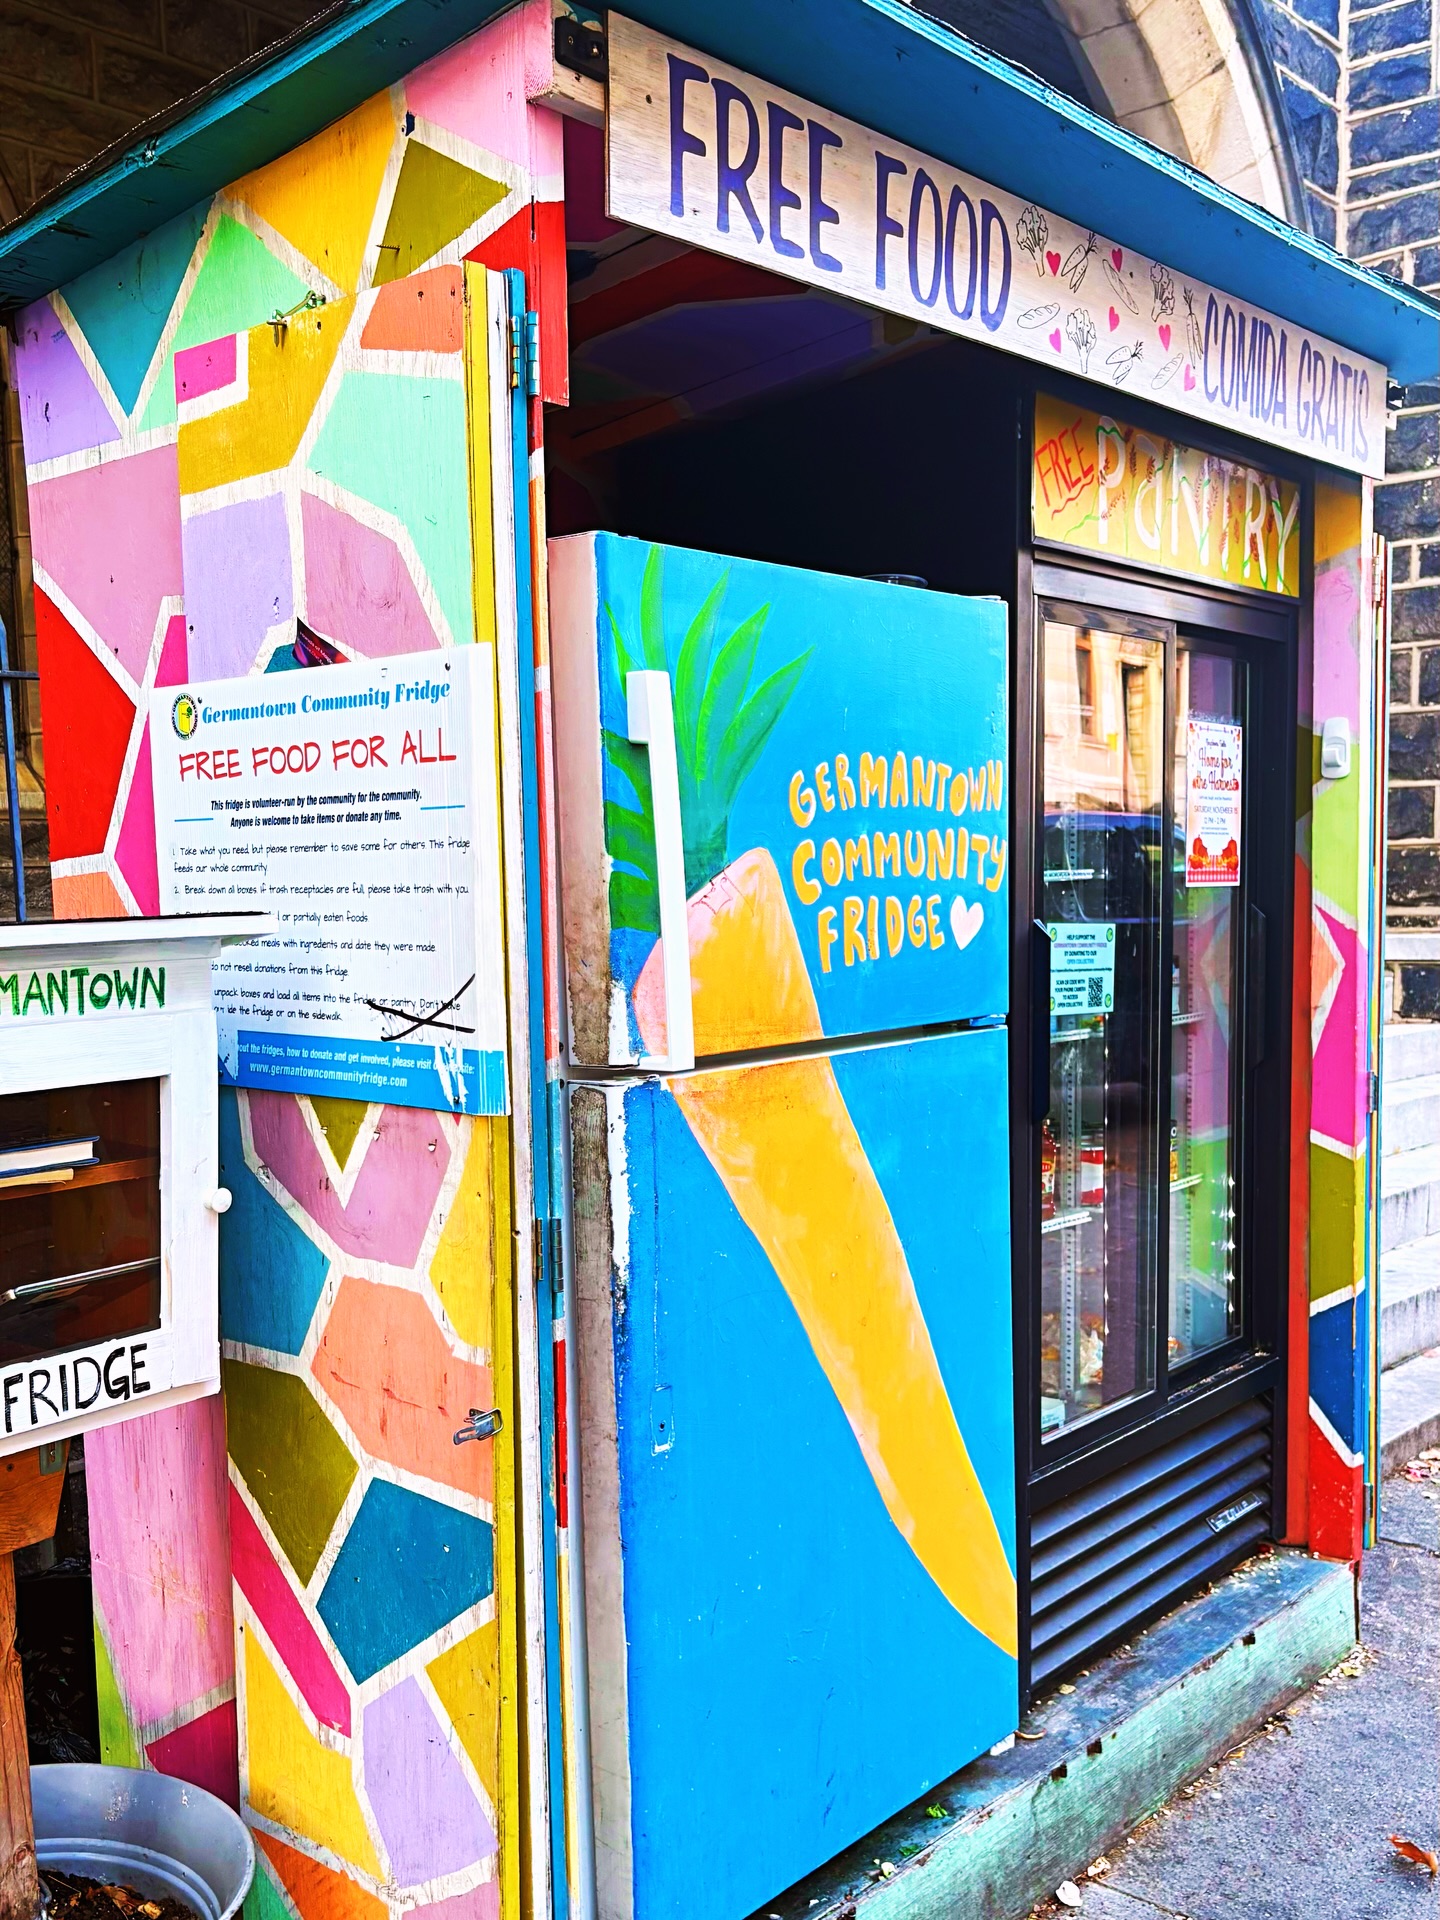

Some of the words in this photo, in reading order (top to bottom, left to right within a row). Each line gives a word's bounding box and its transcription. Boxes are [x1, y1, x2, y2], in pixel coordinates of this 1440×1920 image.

[667, 53, 843, 273] FREE
[875, 151, 1012, 331] FOOD
[1203, 293, 1288, 429] COMIDA
[1297, 339, 1369, 462] GRATIS
[1034, 418, 1094, 507] FREE
[202, 701, 296, 724] Germantown
[301, 687, 390, 713] Community
[395, 680, 450, 704] Fridge
[179, 749, 242, 781] FREE
[252, 742, 321, 776] FOOD
[332, 735, 388, 771] FOR
[401, 728, 457, 765] ALL
[211, 800, 223, 811] This
[225, 799, 243, 811] fridge
[245, 799, 250, 809] is
[252, 797, 295, 809] volunteer-run
[297, 795, 305, 808] by
[307, 794, 317, 805] the
[319, 793, 356, 805] community
[358, 791, 367, 803] for
[369, 791, 380, 802] the
[382, 788, 422, 802] community.
[789, 751, 1002, 828] GERMANTOWN
[230, 817, 253, 829] Anyone
[255, 816, 261, 826] is
[262, 815, 290, 826] welcome
[292, 815, 299, 825] to
[301, 814, 315, 825] take
[317, 813, 335, 824] items
[337, 813, 344, 823] or
[346, 811, 368, 823] donate
[370, 812, 383, 823] any
[384, 809, 401, 821] time.
[180, 846, 197, 856] Take
[200, 845, 215, 855] what
[219, 848, 230, 860] you
[252, 843, 263, 854] but
[266, 843, 287, 858] please
[290, 842, 328, 853] remember
[331, 842, 339, 852] to
[341, 843, 358, 852] save
[361, 842, 380, 851] some
[384, 838, 397, 851] for
[429, 839, 444, 850] This
[448, 835, 471, 855] fridge
[174, 861, 193, 873] feeds
[196, 864, 207, 872] our
[210, 862, 229, 872] whole
[792, 827, 1007, 905] COMMUNITY
[185, 884, 206, 894] Break
[208, 884, 226, 894] down
[269, 884, 288, 894] trash
[290, 884, 334, 898] receptacles
[336, 885, 349, 894] are
[368, 884, 390, 898] please
[394, 883, 410, 894] take
[414, 884, 434, 894] trash
[437, 883, 453, 894] with
[282, 912, 290, 921] or
[294, 911, 321, 927] partially
[324, 912, 343, 922] eaten
[818, 894, 945, 973] FRIDGE
[261, 939, 280, 948] meals
[283, 939, 297, 948] with
[341, 939, 353, 950] and
[355, 939, 371, 950] date
[374, 940, 390, 955] they
[393, 942, 413, 952] were
[220, 962, 231, 972] not
[234, 963, 252, 972] resell
[254, 962, 286, 974] donations
[289, 962, 308, 975] from
[311, 965, 323, 975] this
[0, 967, 165, 1016] MANTOWN
[214, 987, 238, 1000] unpack
[240, 987, 260, 998] boxes
[263, 988, 274, 999] and
[277, 989, 290, 1000] load
[302, 990, 320, 1002] items
[323, 992, 336, 1003] into
[339, 993, 351, 1003] the
[239, 1005, 250, 1015] the
[252, 1004, 273, 1021] fridge
[276, 1009, 284, 1018] or
[287, 1009, 296, 1018] on
[298, 1009, 309, 1019] the
[250, 1043, 260, 1054] the
[262, 1044, 285, 1057] fridges,
[287, 1046, 300, 1057] how
[302, 1048, 309, 1058] to
[310, 1048, 332, 1060] donate
[334, 1051, 346, 1062] and
[348, 1053, 359, 1064] get
[361, 1053, 390, 1067] involved,
[392, 1057, 415, 1069] please
[417, 1057, 431, 1070] visit
[250, 1062, 407, 1087] www.germantowncommunityfridge.com
[4, 1343, 150, 1433] FRIDGE
